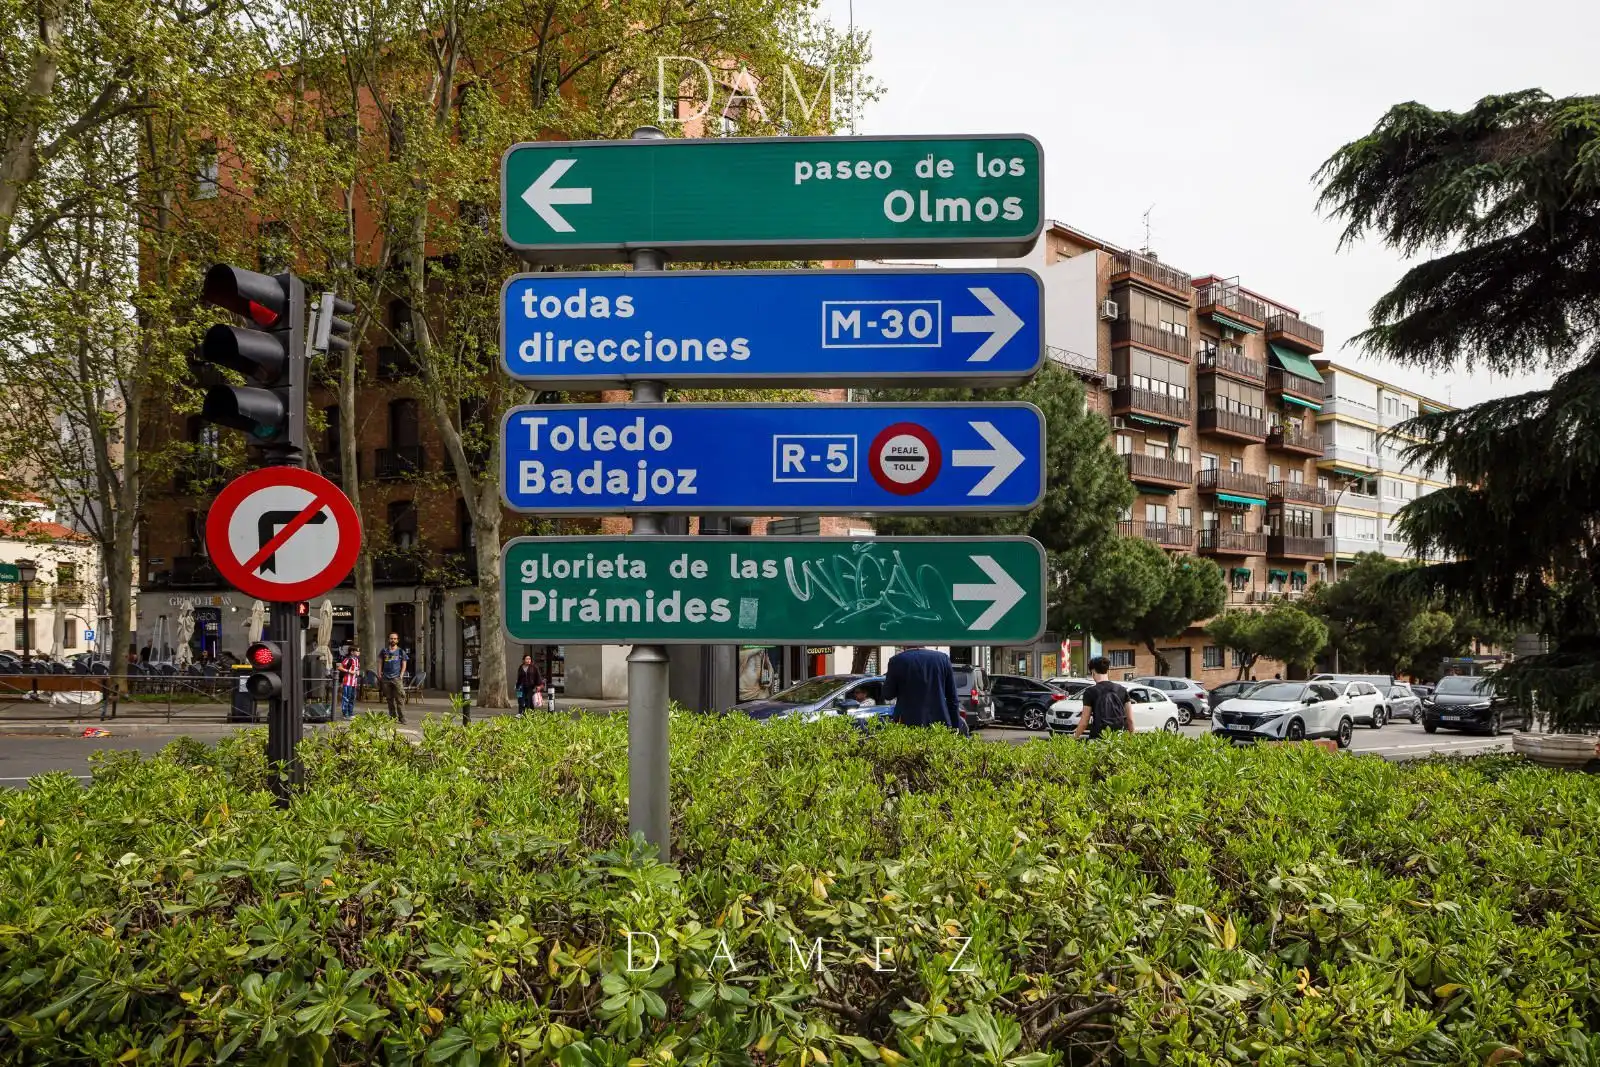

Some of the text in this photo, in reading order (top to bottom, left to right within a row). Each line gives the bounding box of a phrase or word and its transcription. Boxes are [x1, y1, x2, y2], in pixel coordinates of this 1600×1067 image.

[795, 153, 1025, 184] paseo de los
[884, 190, 1023, 222] Olmos
[522, 288, 634, 318] todas
[832, 309, 932, 338] M-30
[519, 331, 750, 362] direcciones
[521, 417, 672, 451] Toledo
[783, 444, 848, 472] R-5
[891, 446, 919, 454] PEAJE
[520, 460, 696, 501] Badajoz
[893, 463, 917, 471] TOLL
[521, 554, 777, 582] glorieta de las
[522, 589, 731, 622] Pirámides
[85, 631, 93, 640] P
